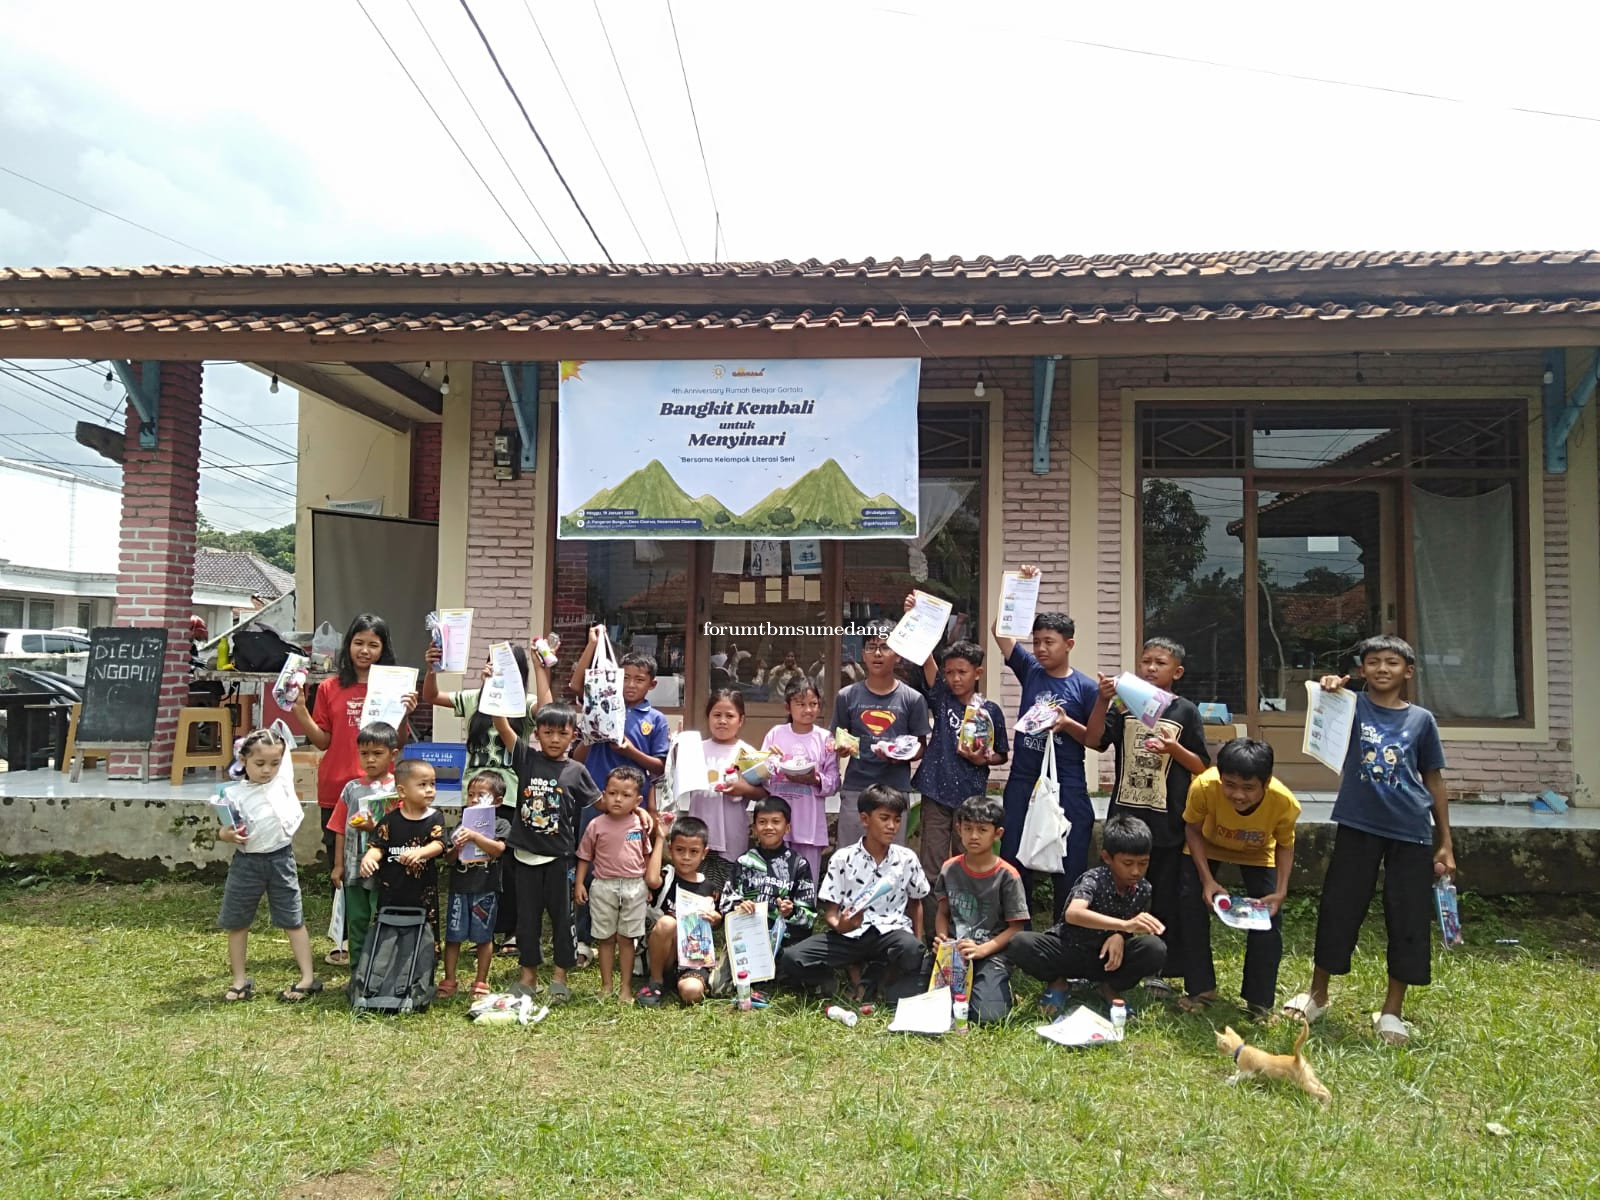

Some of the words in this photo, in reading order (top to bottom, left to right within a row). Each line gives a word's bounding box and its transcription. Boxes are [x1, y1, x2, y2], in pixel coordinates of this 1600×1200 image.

[684, 387, 724, 396] Anniversary
[660, 401, 734, 418] Bangkit
[736, 400, 815, 415] Kembali
[719, 420, 755, 429] untuk
[688, 431, 786, 449] Menyinari
[714, 456, 750, 464] Kelompok
